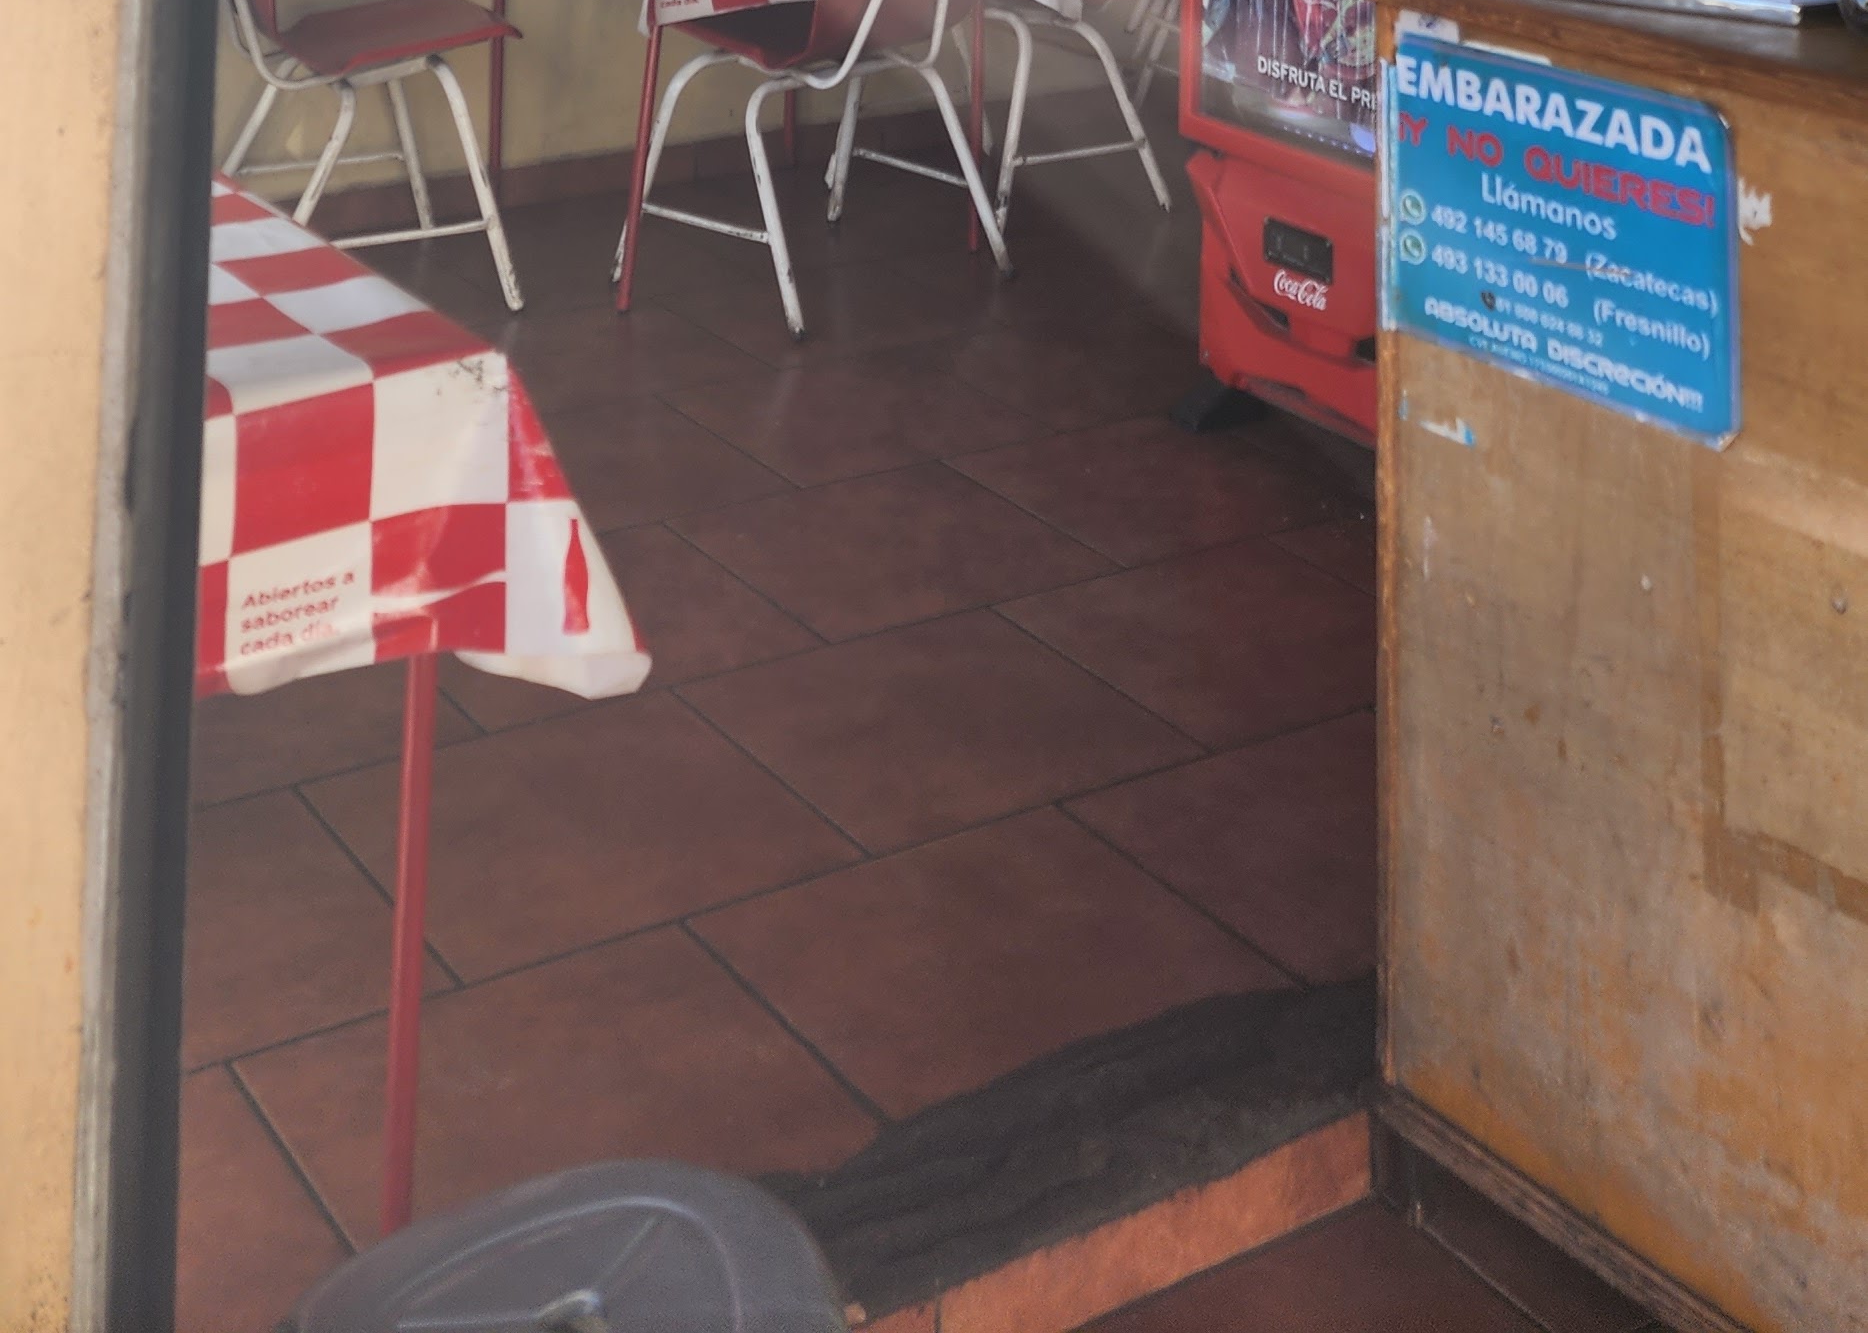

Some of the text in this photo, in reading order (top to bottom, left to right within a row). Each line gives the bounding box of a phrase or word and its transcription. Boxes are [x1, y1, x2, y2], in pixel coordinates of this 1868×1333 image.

[1257, 55, 1377, 111] DISFRUTA EL PRI
[1396, 53, 1713, 174] EMBARAZADA
[1447, 124, 1503, 167] NO
[1524, 144, 1715, 230] QUIERES!
[1481, 171, 1617, 241] Llámanos
[1431, 205, 1719, 320] 492 145 68 79 (Zacatecas)
[1424, 295, 1538, 353] ABSOLUTA
[1431, 244, 1468, 274] 493
[1474, 256, 1508, 288] 133
[1512, 269, 1538, 298] 00
[1593, 297, 1711, 361] (Fresnillo)
[242, 571, 354, 610] Abiertos a
[242, 595, 338, 633] saborear
[241, 632, 293, 656] cada
